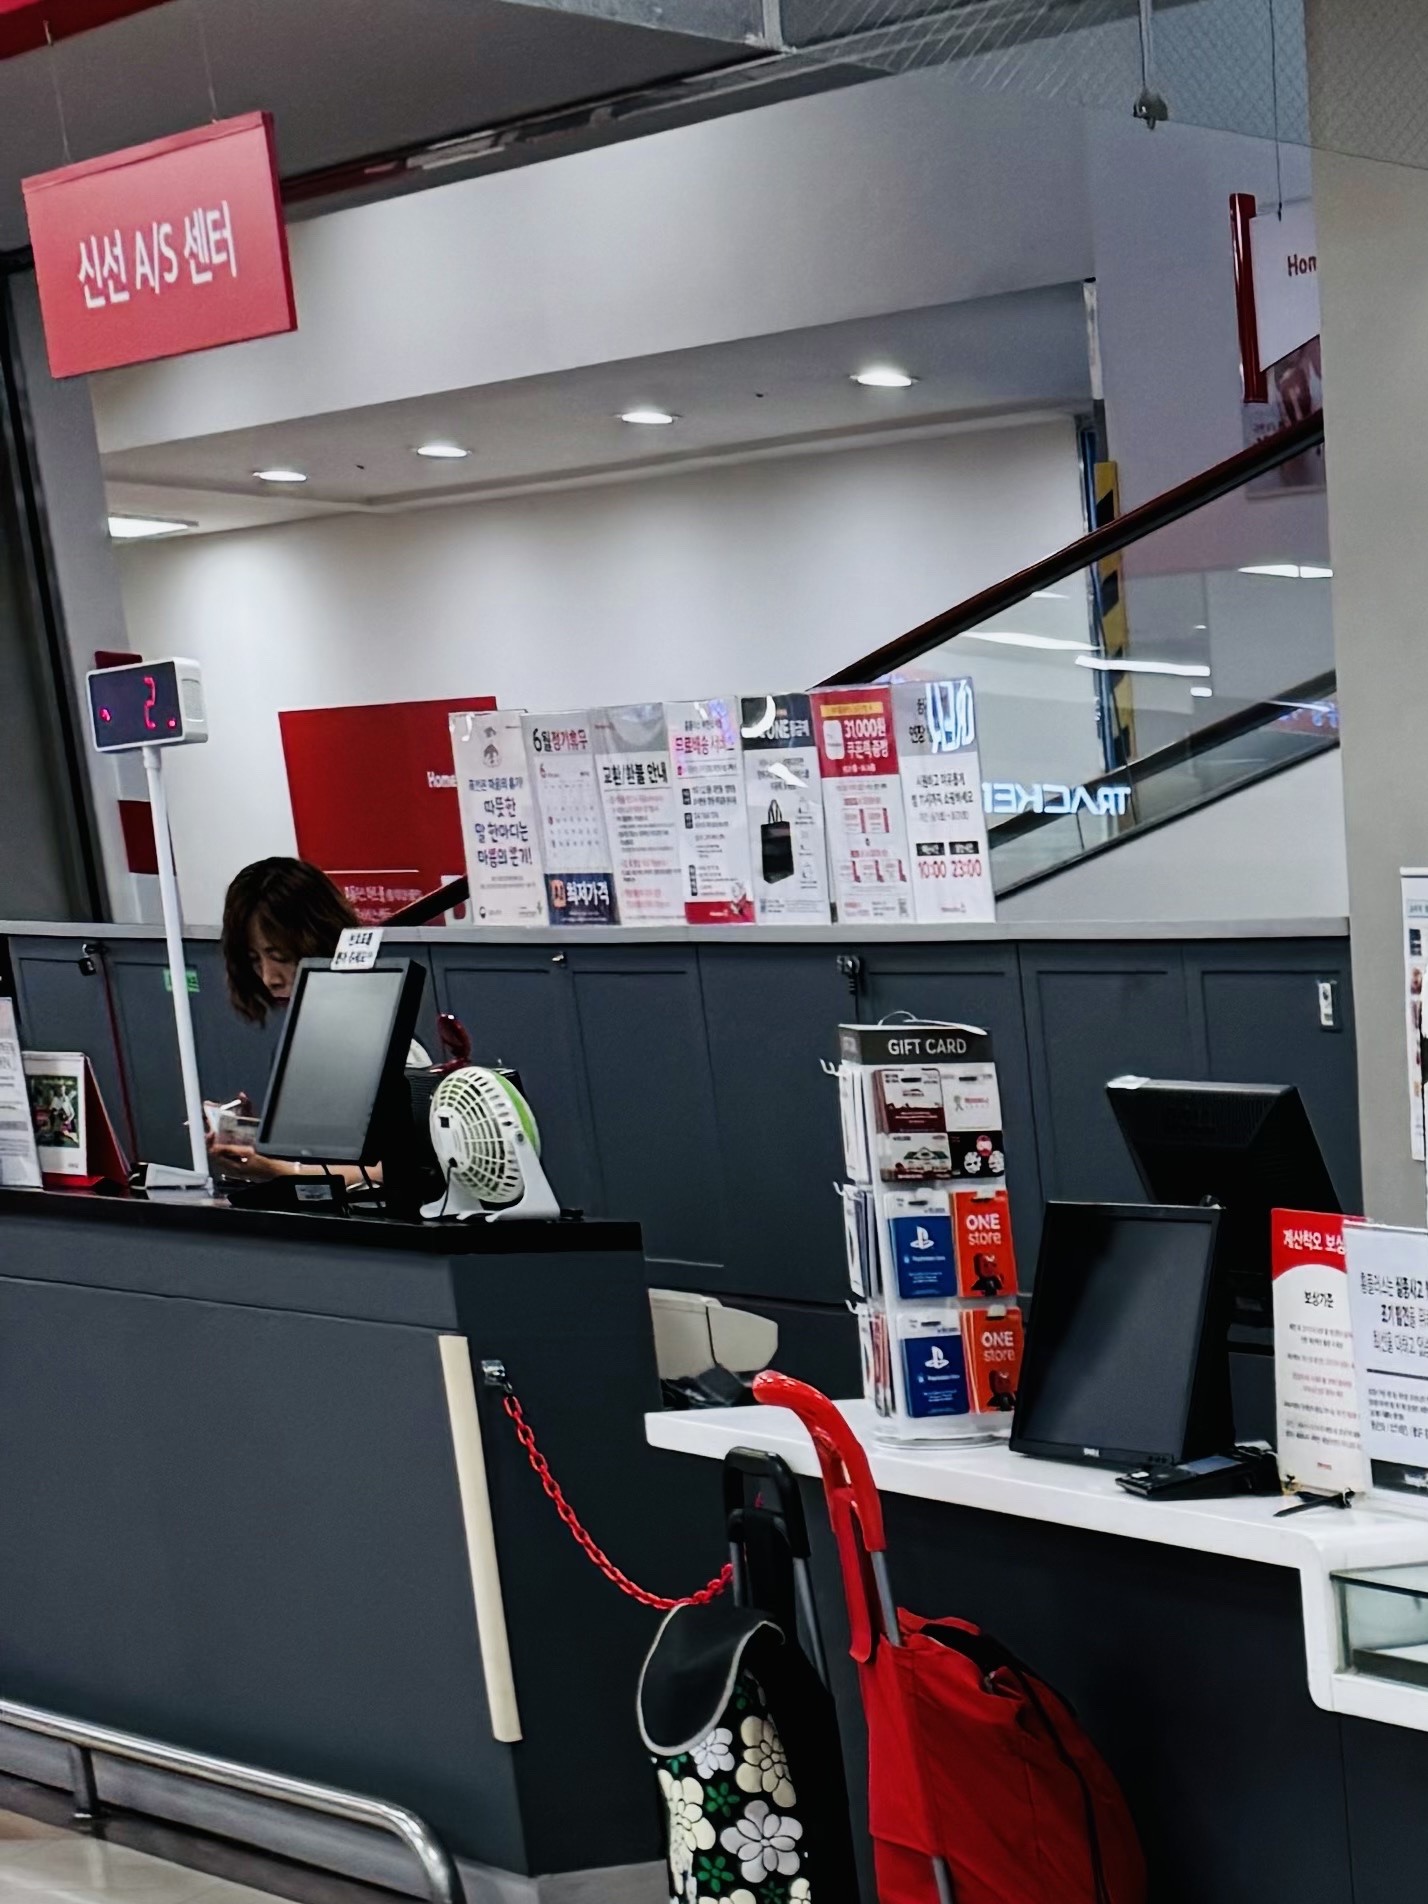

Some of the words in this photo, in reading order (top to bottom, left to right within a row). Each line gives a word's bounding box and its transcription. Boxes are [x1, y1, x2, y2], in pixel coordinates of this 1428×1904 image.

[78, 229, 130, 309] 신선
[135, 221, 179, 295] A/S
[184, 199, 237, 285] 센터
[887, 1038, 921, 1055] GIFT
[925, 1038, 967, 1055] CARD
[966, 1213, 1001, 1230] ONE
[968, 1230, 1002, 1246] store
[981, 1331, 1014, 1347] ONE
[983, 1346, 1016, 1362] store
